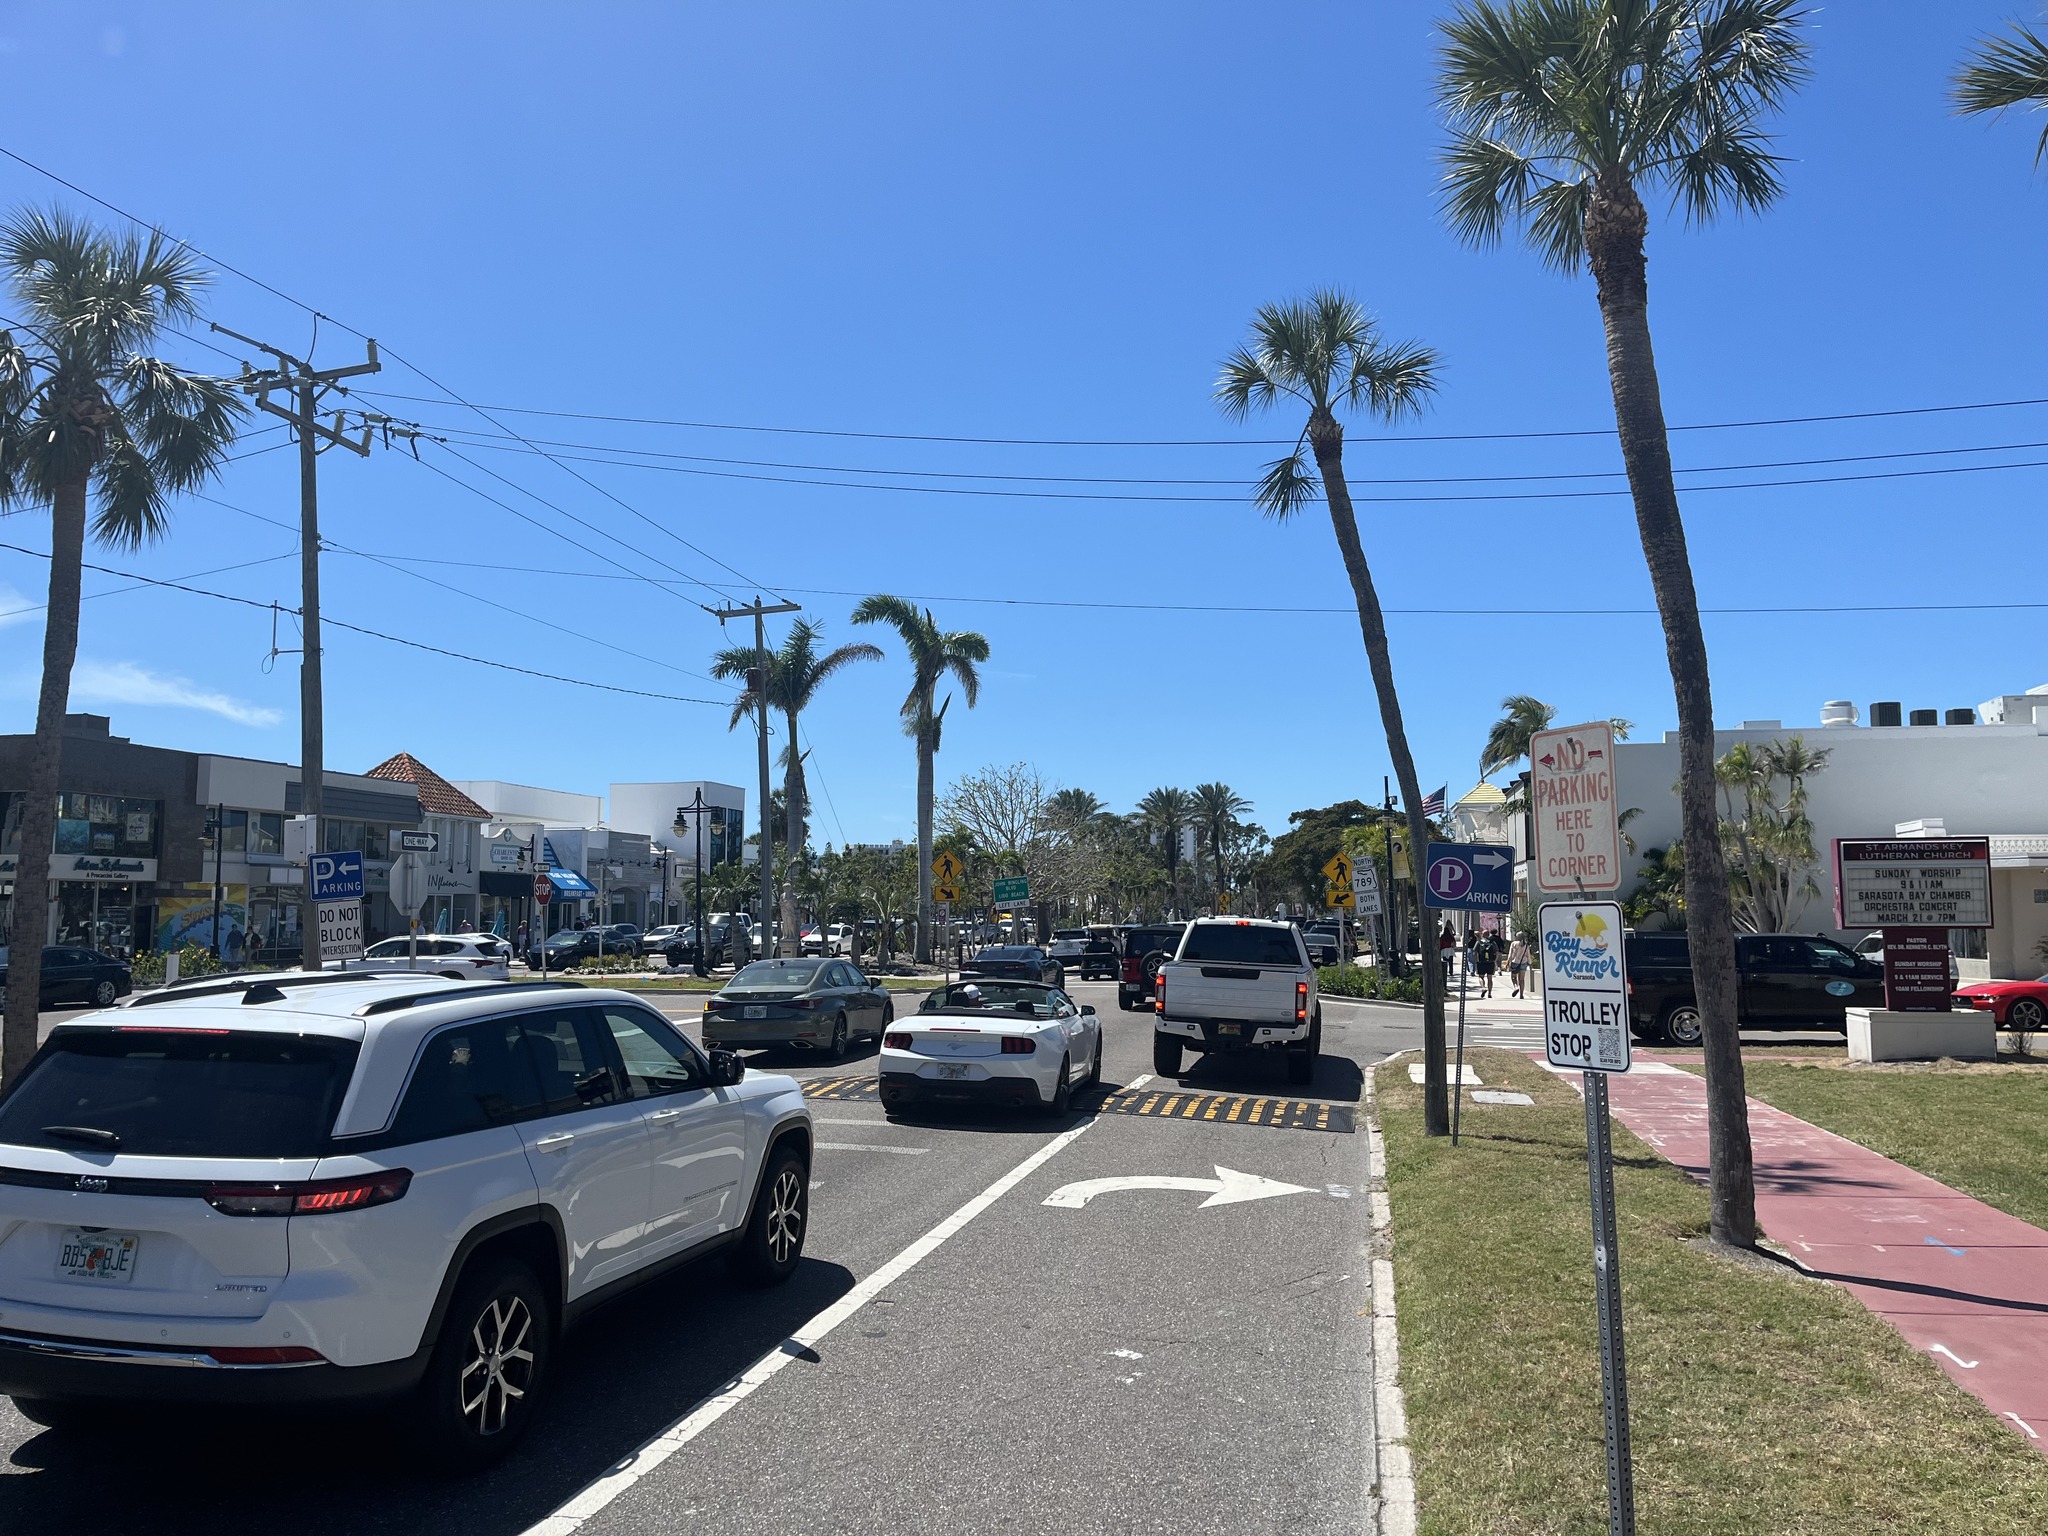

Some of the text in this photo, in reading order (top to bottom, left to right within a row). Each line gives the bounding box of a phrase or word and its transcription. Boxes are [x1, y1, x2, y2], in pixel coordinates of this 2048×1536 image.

[1557, 740, 1585, 771] NO
[1538, 771, 1609, 807] PARKING
[1556, 809, 1593, 831] HERE
[405, 837, 428, 846] ONE WAY
[1567, 833, 1585, 853] TO
[1884, 843, 1939, 851] ARMANDS
[1353, 858, 1372, 867] NORTH
[1859, 852, 1919, 860] LUTHERAN
[1549, 855, 1607, 877] CORNER
[1875, 869, 1961, 878] SUNDAY WORSHIP
[1354, 877, 1372, 888] 789
[1900, 880, 1907, 889] 9
[1918, 880, 1943, 889] 11AM
[535, 883, 551, 896] STOP
[1858, 890, 1971, 900] SARASOTA BAY CHAMBER
[1359, 894, 1375, 903] BOTH
[1360, 904, 1379, 914] LANES
[1864, 902, 1958, 911] ORCHESTRA CONCERT
[320, 907, 359, 924] DO NOT
[1877, 913, 1908, 922] MARCH
[1912, 913, 1923, 922] 21
[1938, 913, 1956, 922] 7PM
[321, 927, 361, 943] BLOCK
[321, 943, 362, 956] INTERSECTION
[1545, 930, 1581, 959] Bay
[1555, 952, 1620, 979] Runner
[1573, 973, 1596, 981] Sarasota
[1549, 1000, 1621, 1026] TROLLEY
[1551, 1032, 1592, 1057] STOP
[75, 1175, 108, 1193] Jeep
